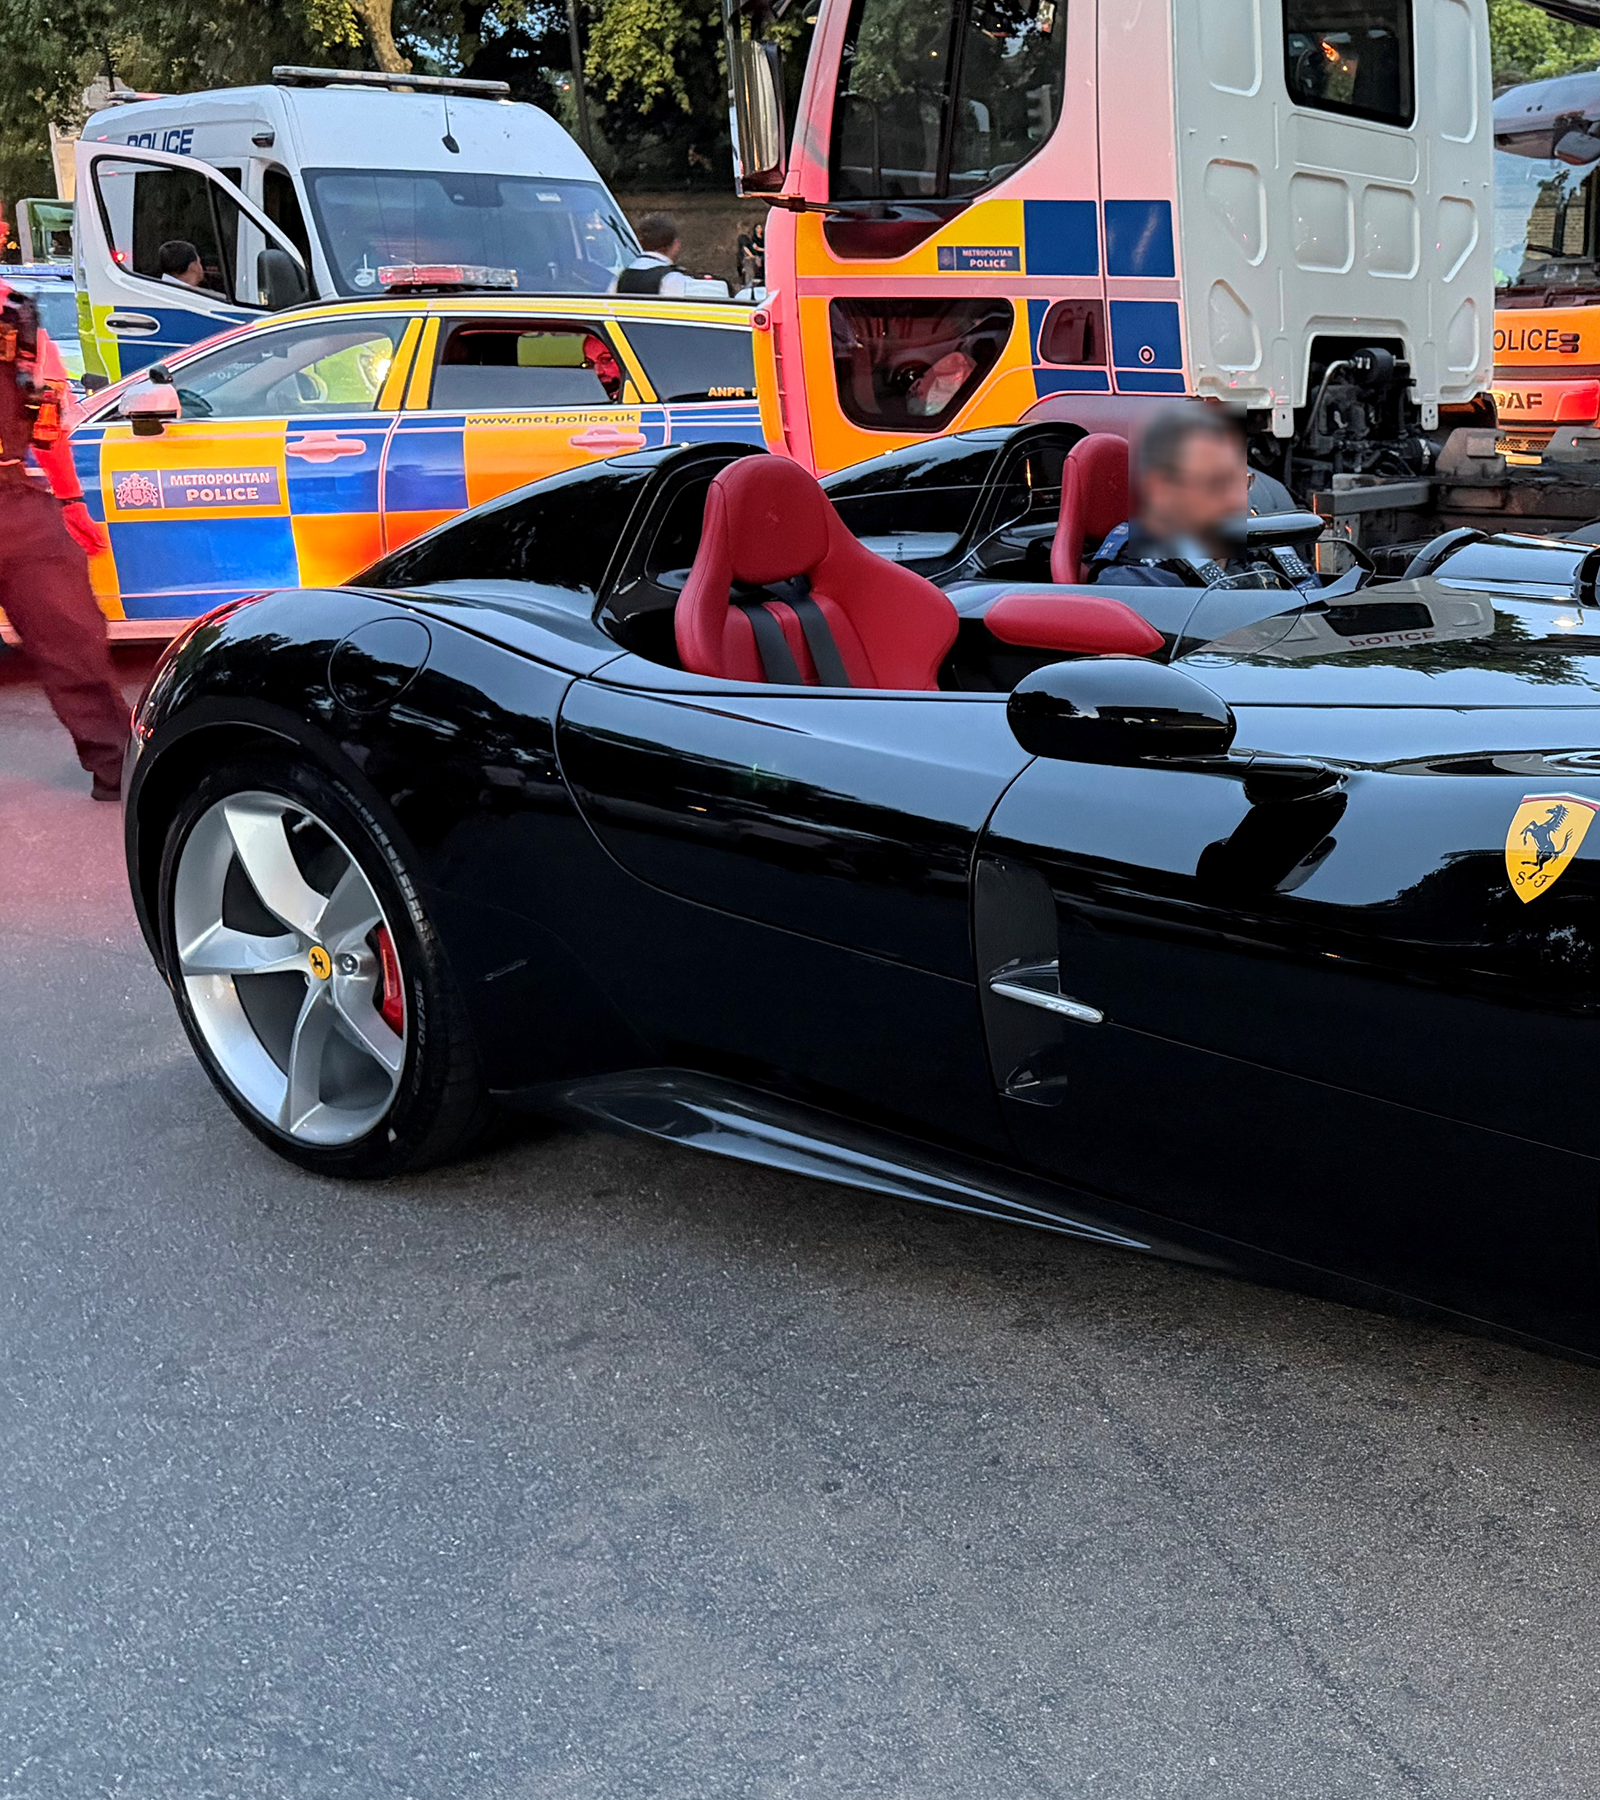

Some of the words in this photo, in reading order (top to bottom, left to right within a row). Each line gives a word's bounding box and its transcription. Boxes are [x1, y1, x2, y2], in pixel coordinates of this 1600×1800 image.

[962, 249, 1013, 257] METROPOLITAN
[969, 259, 1006, 268] POLICE
[1493, 329, 1559, 351] OLICE
[707, 387, 745, 397] ANPR
[467, 413, 636, 425] www.met.police.uk
[170, 472, 270, 486] METROPOLITAN
[185, 487, 260, 502] POLICE
[1515, 870, 1527, 886] S
